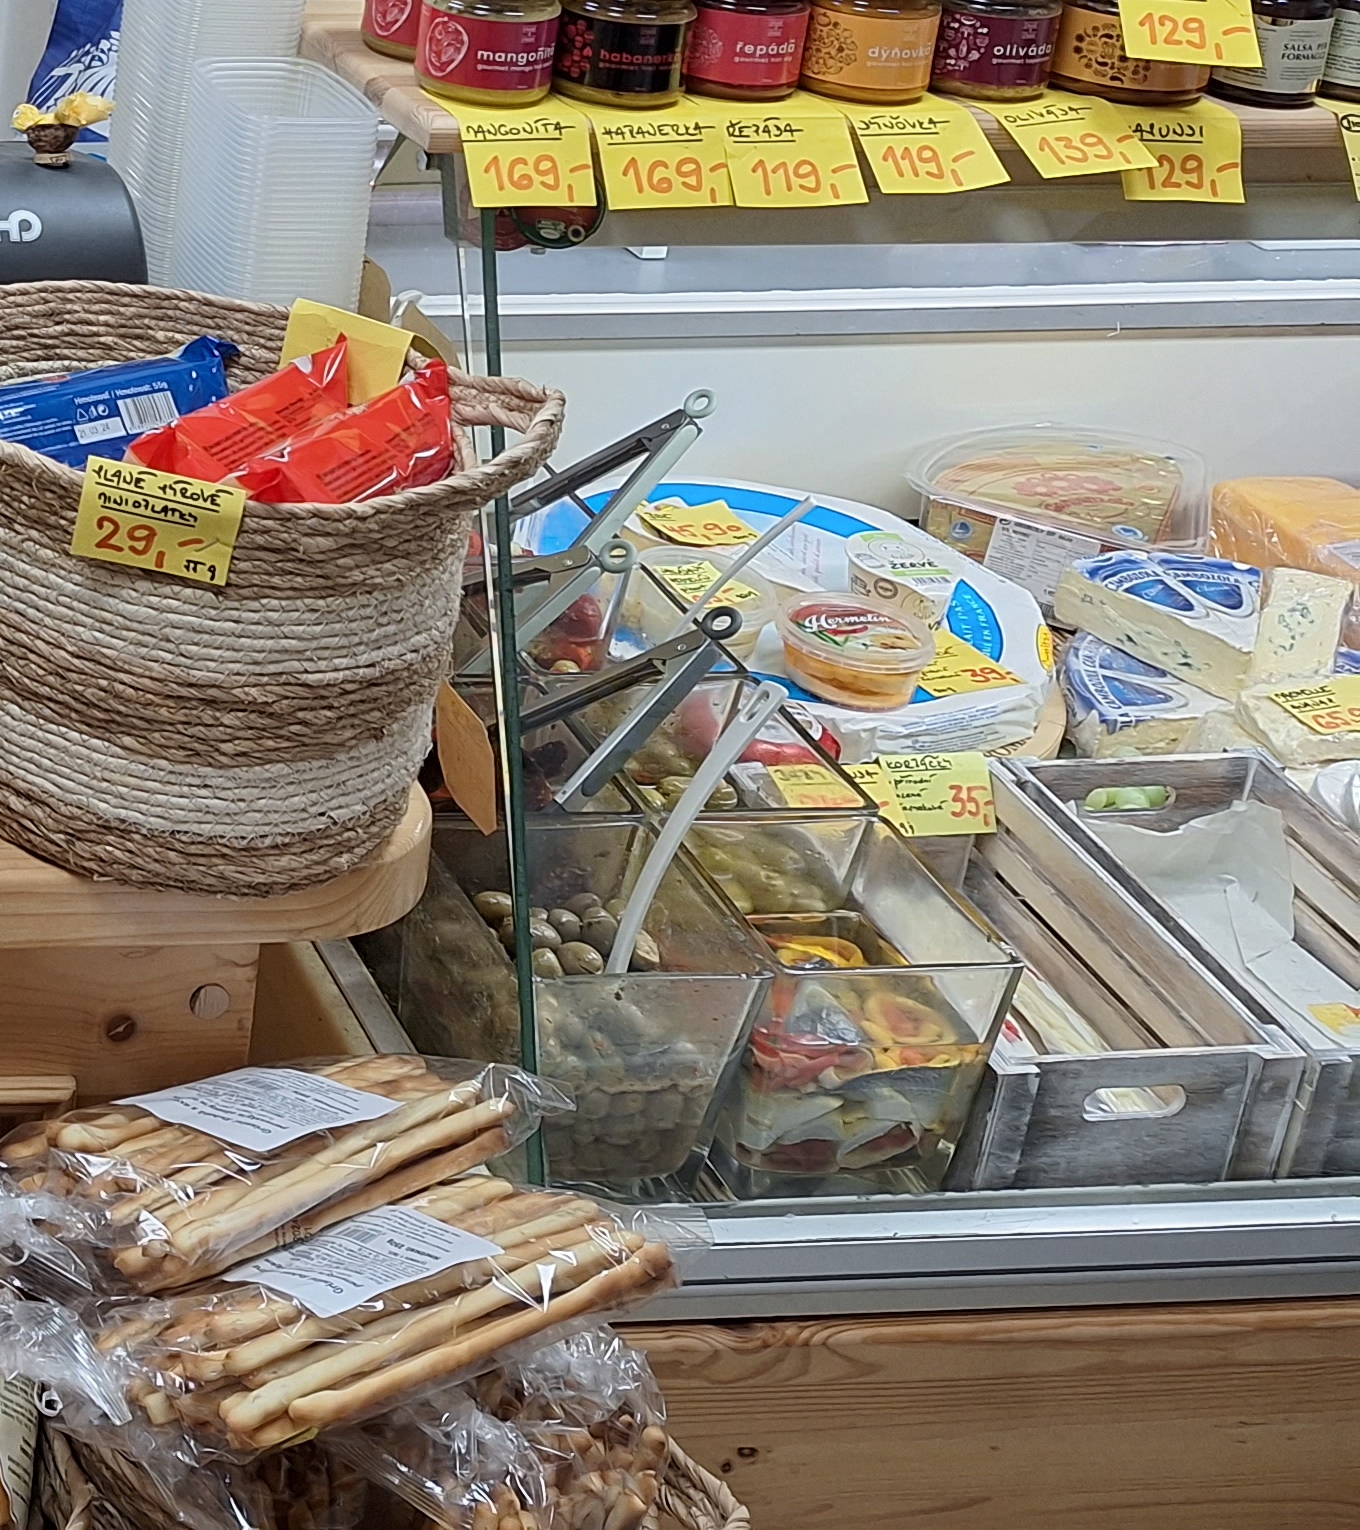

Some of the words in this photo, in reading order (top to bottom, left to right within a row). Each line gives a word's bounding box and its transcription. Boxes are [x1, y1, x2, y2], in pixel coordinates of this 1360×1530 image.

[1137, 12, 1252, 60] 129,-
[1283, 41, 1315, 52] SALSA
[881, 143, 975, 186] 119,-
[1037, 130, 1140, 166] 139,-
[483, 153, 592, 204] 169,-
[621, 155, 728, 203] 169,-
[751, 157, 857, 200] 119,-
[93, 514, 203, 569] 29,-
[887, 556, 939, 571] ŽERVÉ
[960, 665, 1023, 686] 39,-
[947, 784, 995, 828] 35,-
